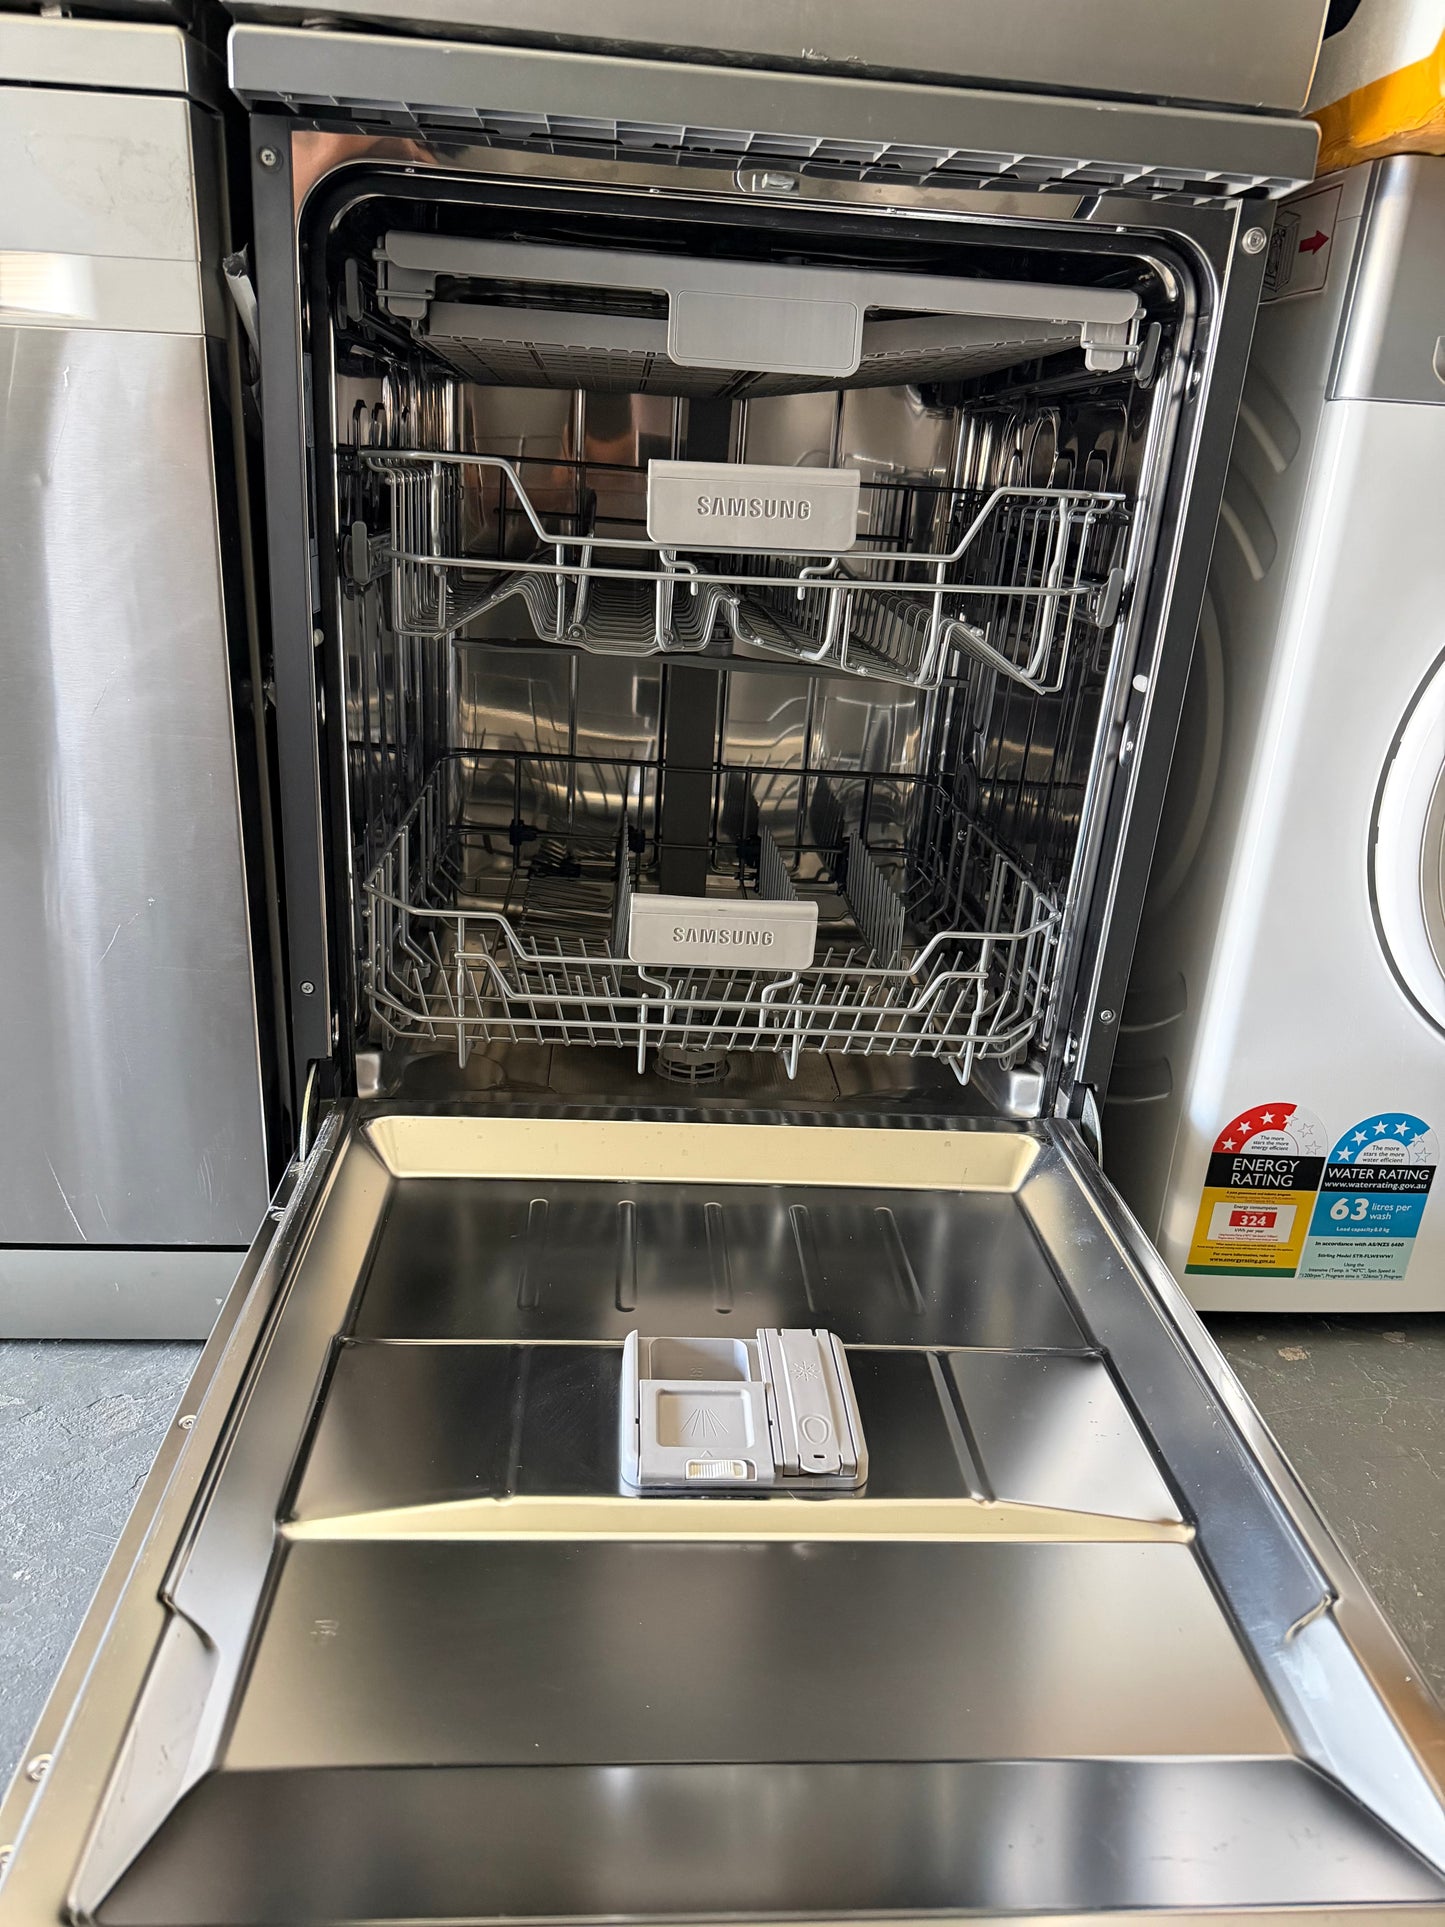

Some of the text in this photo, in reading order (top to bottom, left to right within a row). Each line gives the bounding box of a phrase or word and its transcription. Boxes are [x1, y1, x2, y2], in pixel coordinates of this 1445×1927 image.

[697, 495, 812, 520] SAMSUNG
[672, 927, 775, 947] SAMSUNG
[1232, 1158, 1300, 1172] ENERGY
[1230, 1173, 1294, 1187] RATING
[1328, 1168, 1430, 1180] WATER RATING
[1324, 1181, 1427, 1190] www.waterrating.gov.au
[1330, 1198, 1412, 1220] 63 litres per
[1370, 1212, 1392, 1220] wash
[1240, 1216, 1266, 1226] 324
